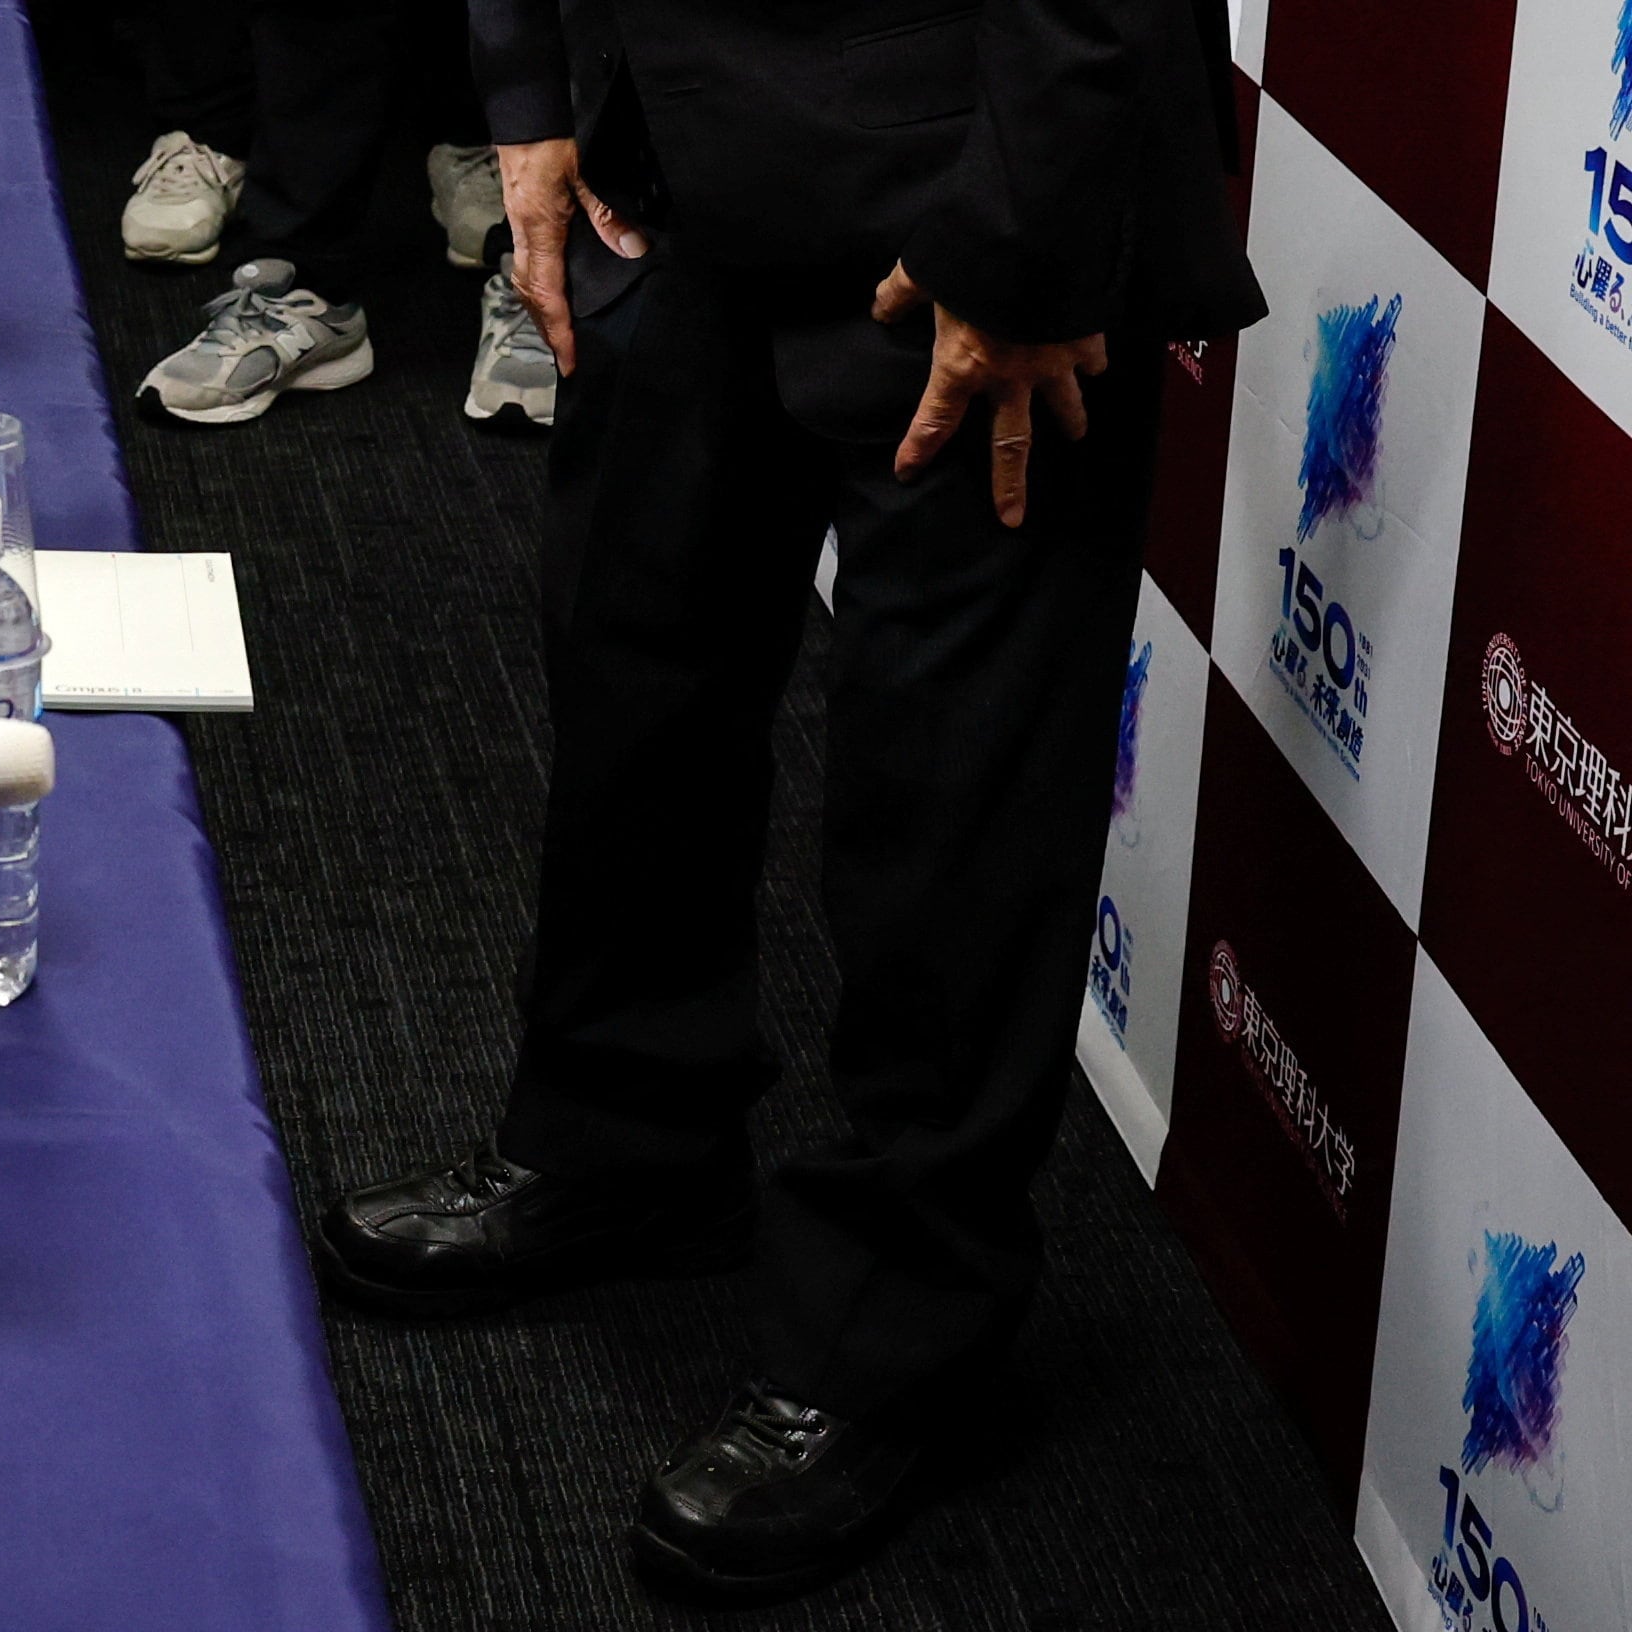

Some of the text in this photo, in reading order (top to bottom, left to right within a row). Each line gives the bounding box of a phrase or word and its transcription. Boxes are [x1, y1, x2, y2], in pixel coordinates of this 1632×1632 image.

[1570, 282, 1598, 324] Building
[1605, 315, 1628, 345] better
[1279, 546, 1356, 690] 150
[1354, 675, 1368, 719] th
[1525, 753, 1558, 805] TOKYO
[1558, 801, 1616, 873] UNIVERSITY
[1241, 983, 1355, 1196] 東京理科大学
[1439, 1464, 1529, 1632] 150
